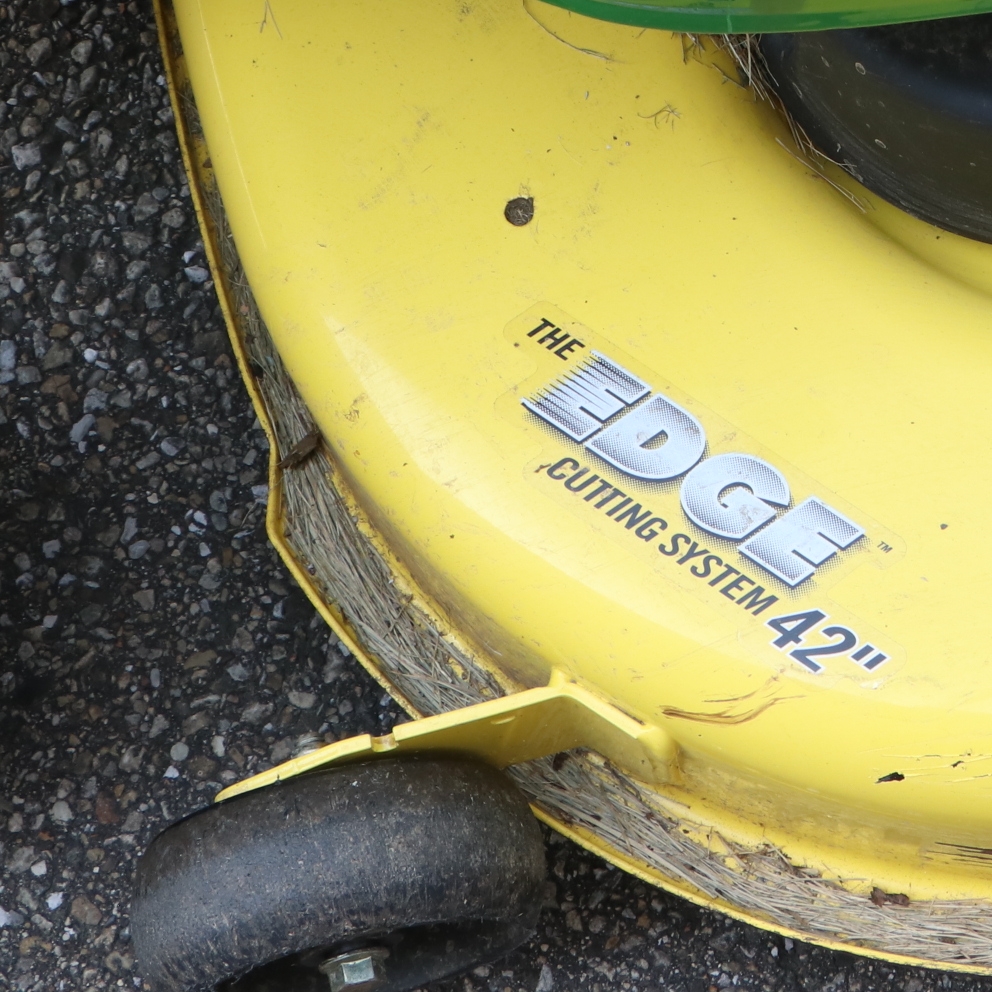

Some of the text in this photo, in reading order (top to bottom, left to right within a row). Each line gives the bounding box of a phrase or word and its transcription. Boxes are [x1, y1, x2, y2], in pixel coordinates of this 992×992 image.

[526, 317, 585, 361] THE
[520, 349, 868, 590] EDGE
[546, 457, 668, 542] CUTTING
[658, 533, 779, 616] SYSTEM
